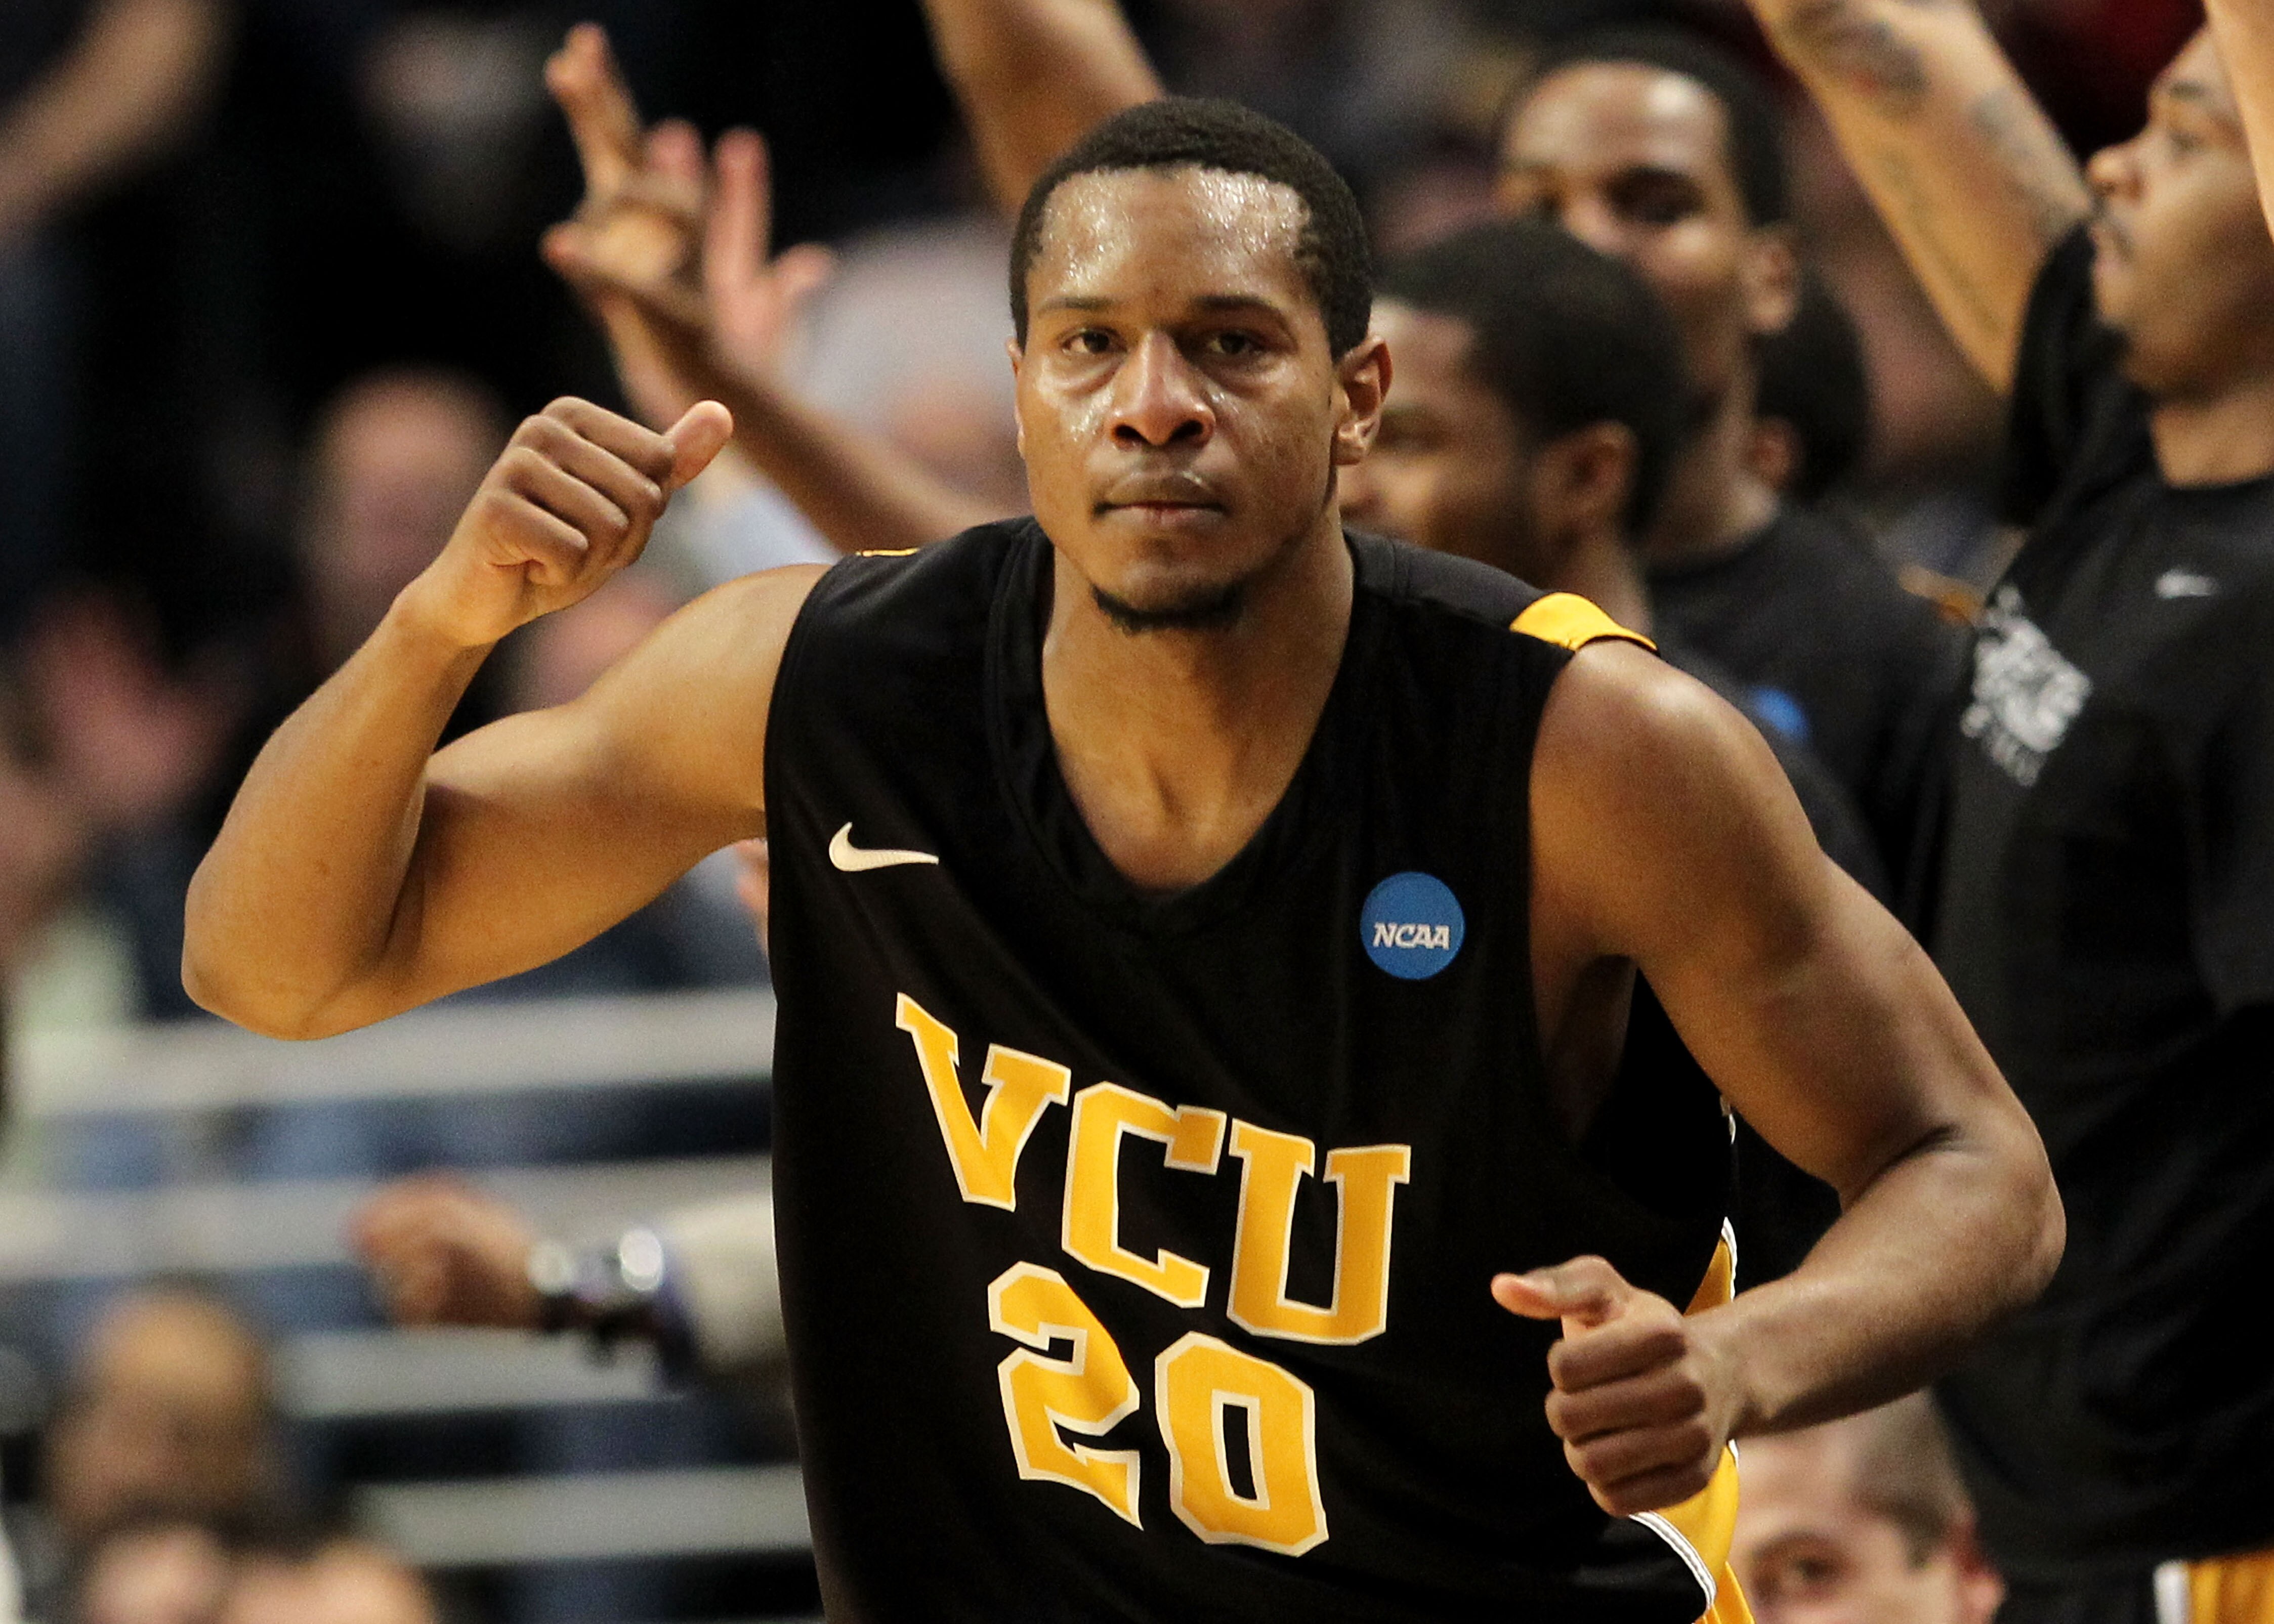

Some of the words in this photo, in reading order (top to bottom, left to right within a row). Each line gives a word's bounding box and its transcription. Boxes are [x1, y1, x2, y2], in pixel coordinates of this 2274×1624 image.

[1372, 922, 1450, 951] NCAA
[896, 992, 1411, 1345] VCU
[988, 1261, 1329, 1557] 20
